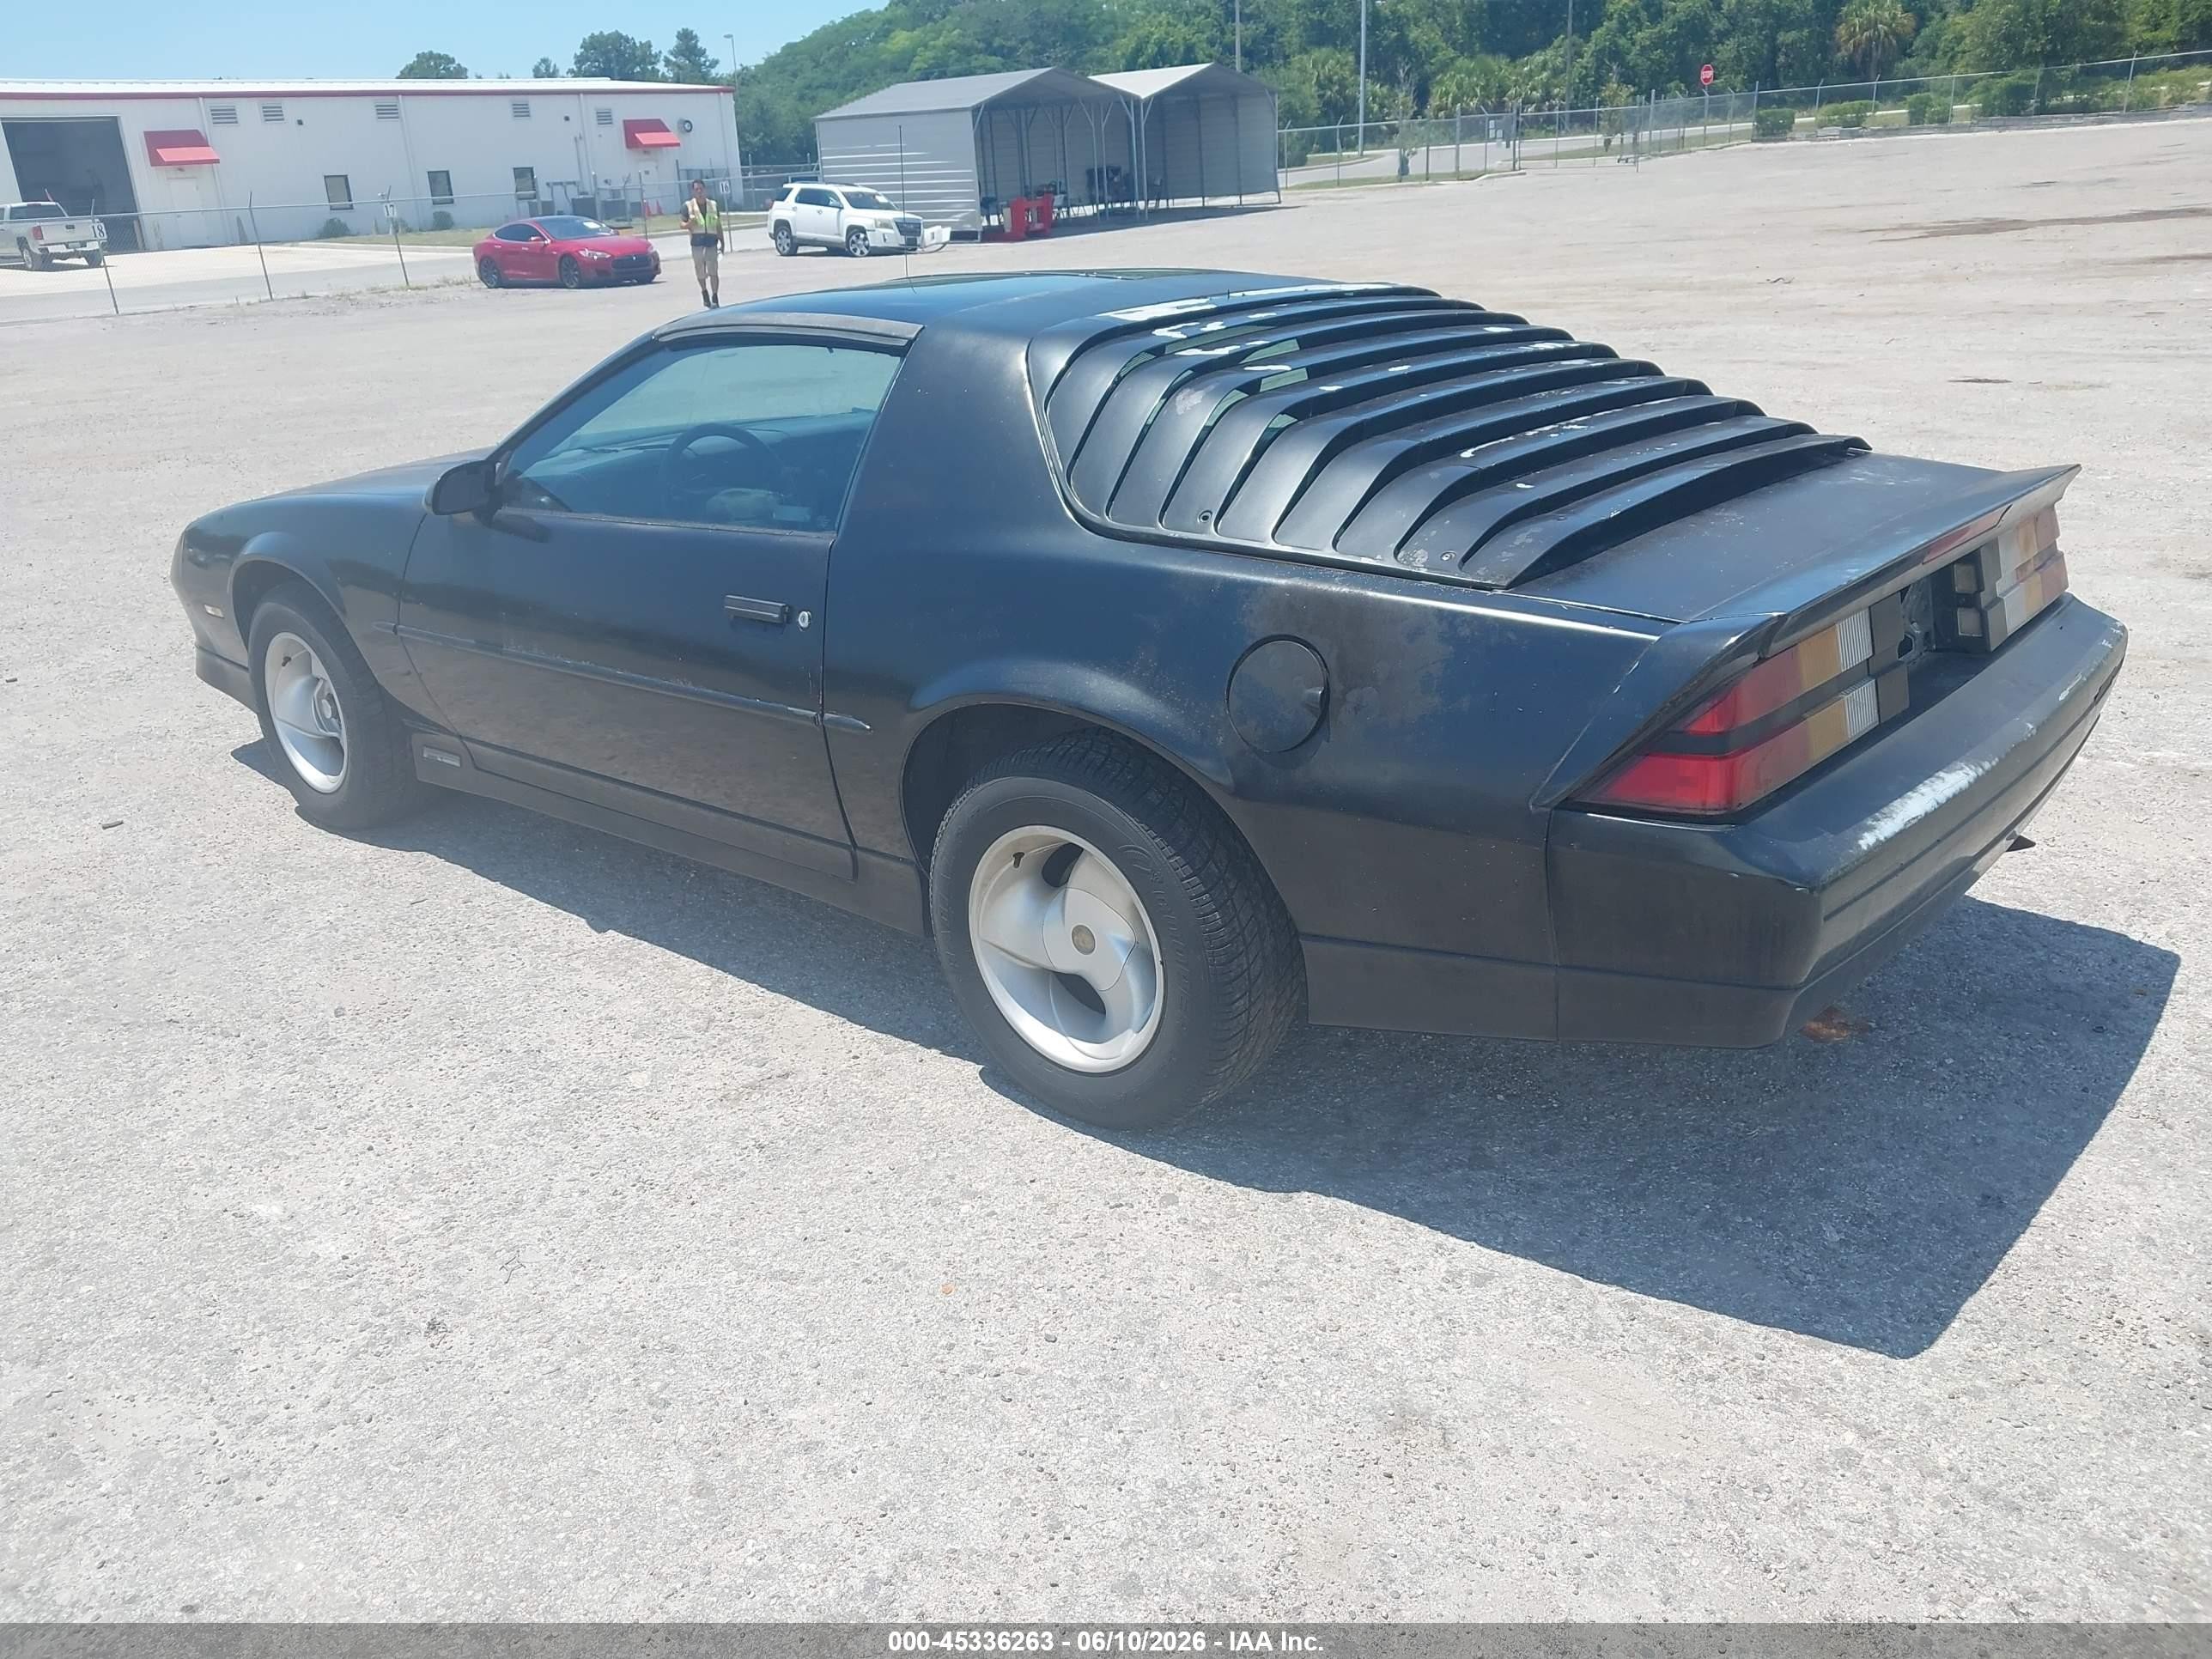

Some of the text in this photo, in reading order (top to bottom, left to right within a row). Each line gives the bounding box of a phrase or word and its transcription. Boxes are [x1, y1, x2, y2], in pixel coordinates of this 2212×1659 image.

[720, 182, 729, 193] 16
[385, 204, 394, 216] 17
[92, 224, 105, 238] 18
